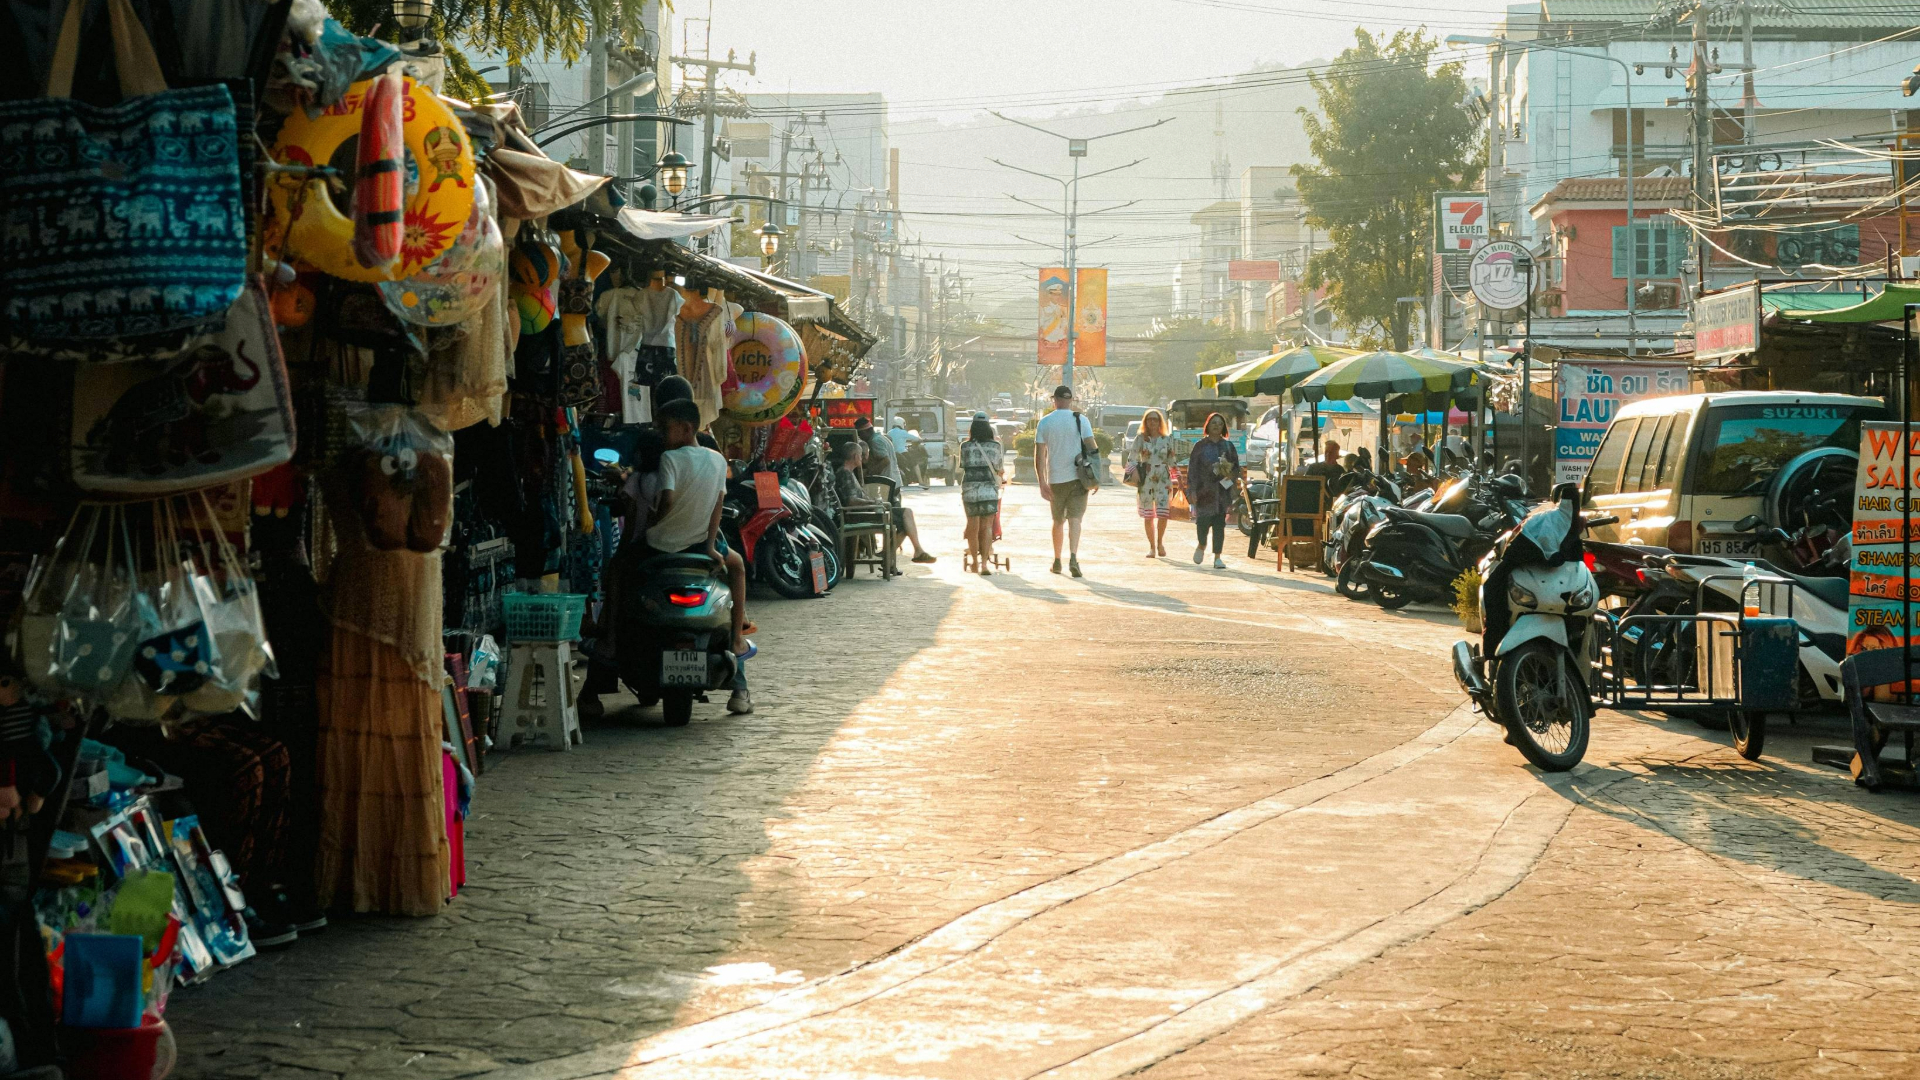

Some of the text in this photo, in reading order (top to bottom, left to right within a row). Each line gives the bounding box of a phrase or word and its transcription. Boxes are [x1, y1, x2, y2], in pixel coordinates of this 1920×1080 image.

[1450, 202, 1483, 249] 7
[1587, 369, 1613, 394] ซัก
[1621, 376, 1649, 395] อบ
[1763, 408, 1838, 419] SUZUKI
[830, 418, 846, 427] FOR
[1580, 433, 1607, 442] WAS
[1859, 496, 1891, 511] HAIR
[1856, 608, 1906, 627] STEAM
[668, 675, 702, 685] 9033
